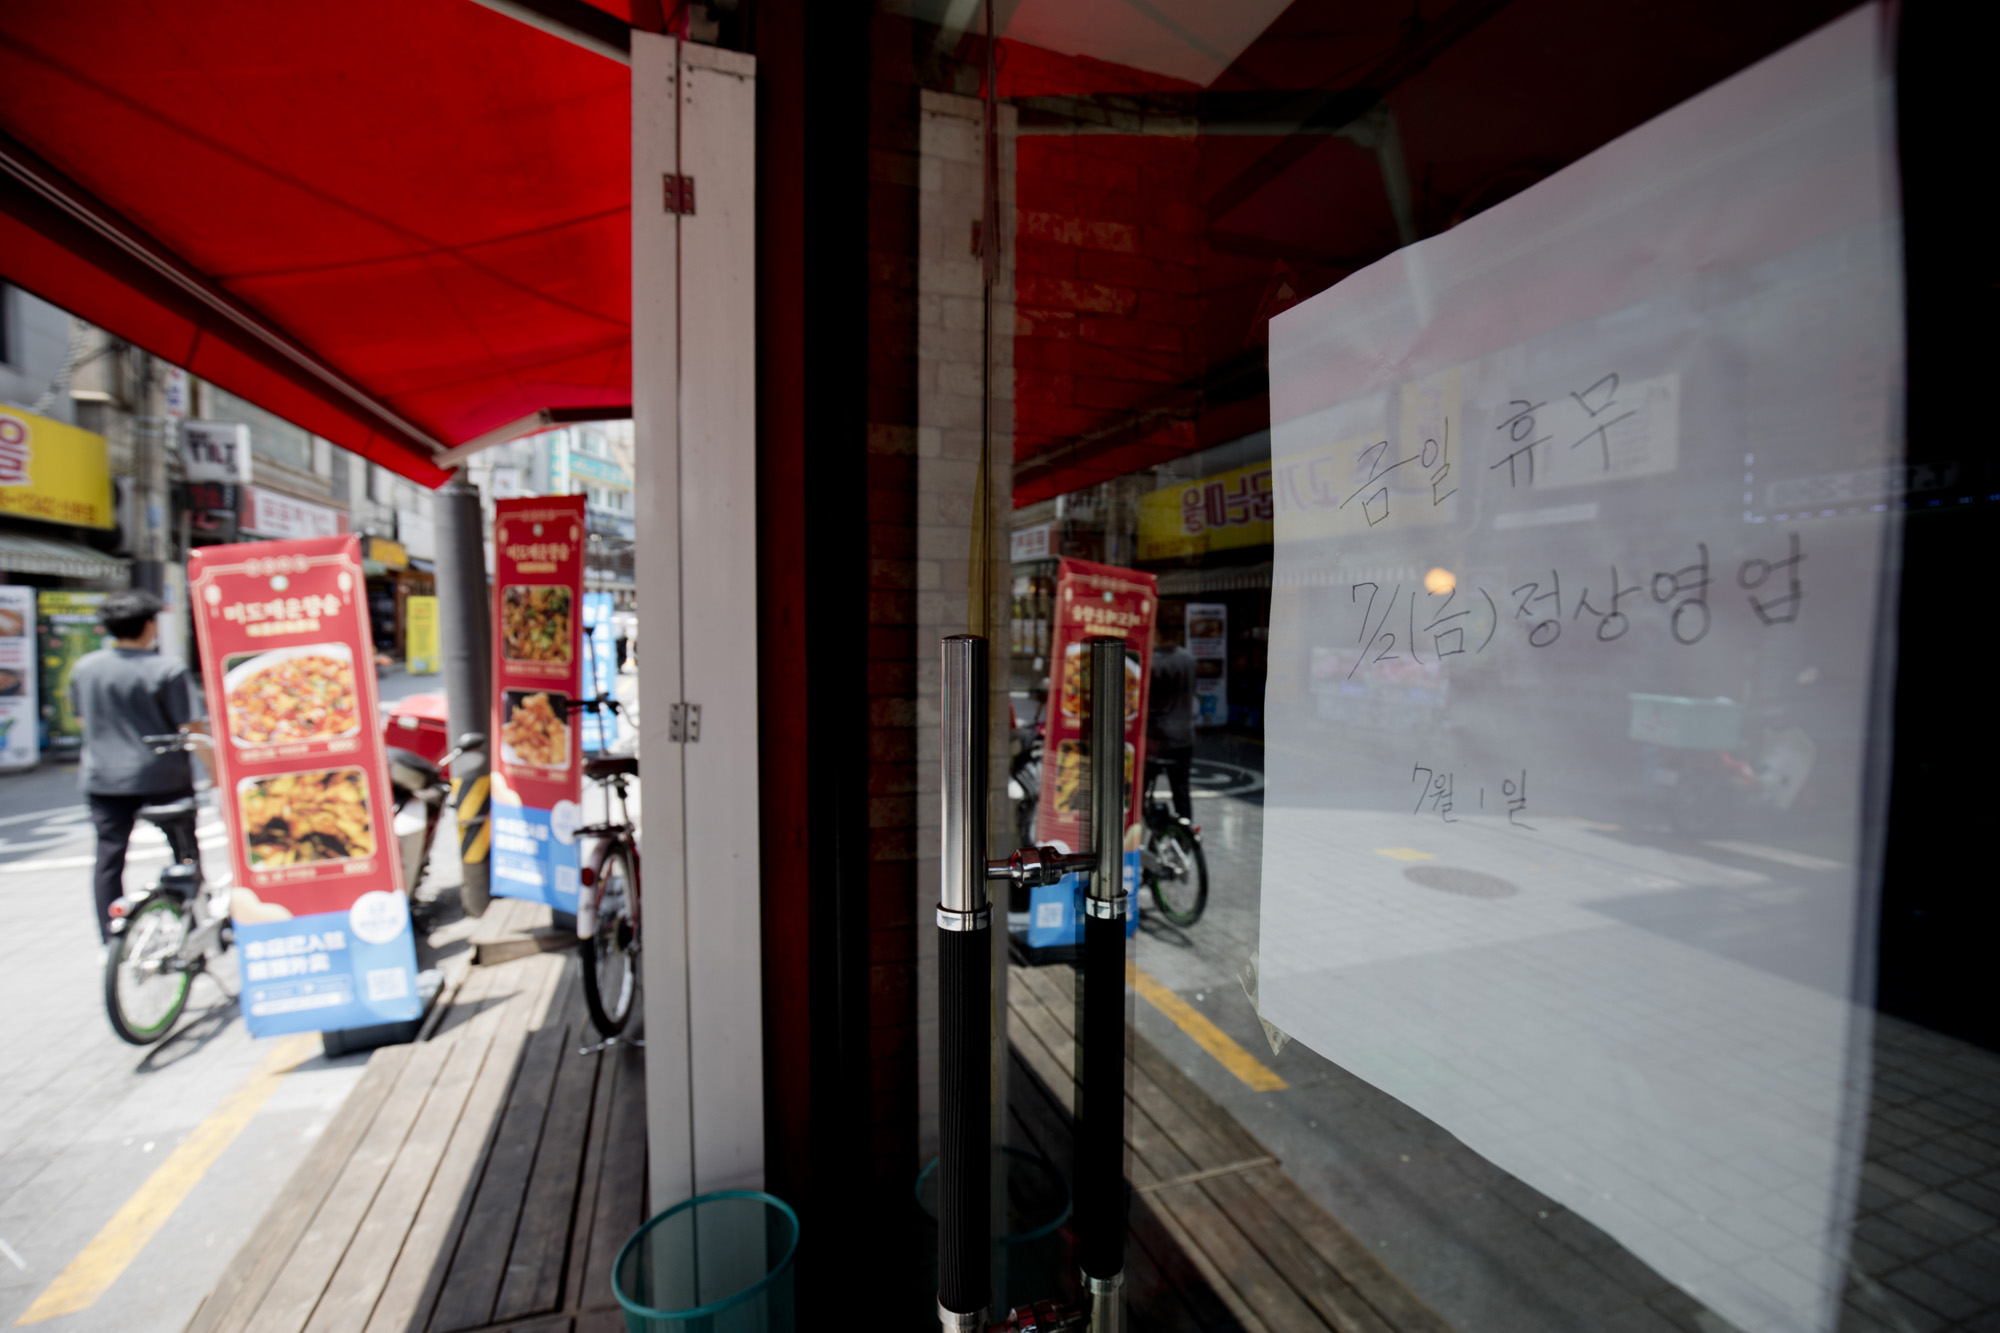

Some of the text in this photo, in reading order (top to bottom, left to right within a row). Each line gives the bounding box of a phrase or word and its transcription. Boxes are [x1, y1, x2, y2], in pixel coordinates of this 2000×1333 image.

[1339, 416, 1458, 528] 금일
[1489, 372, 1637, 488] 휴무
[1511, 532, 1809, 647] 정상영업
